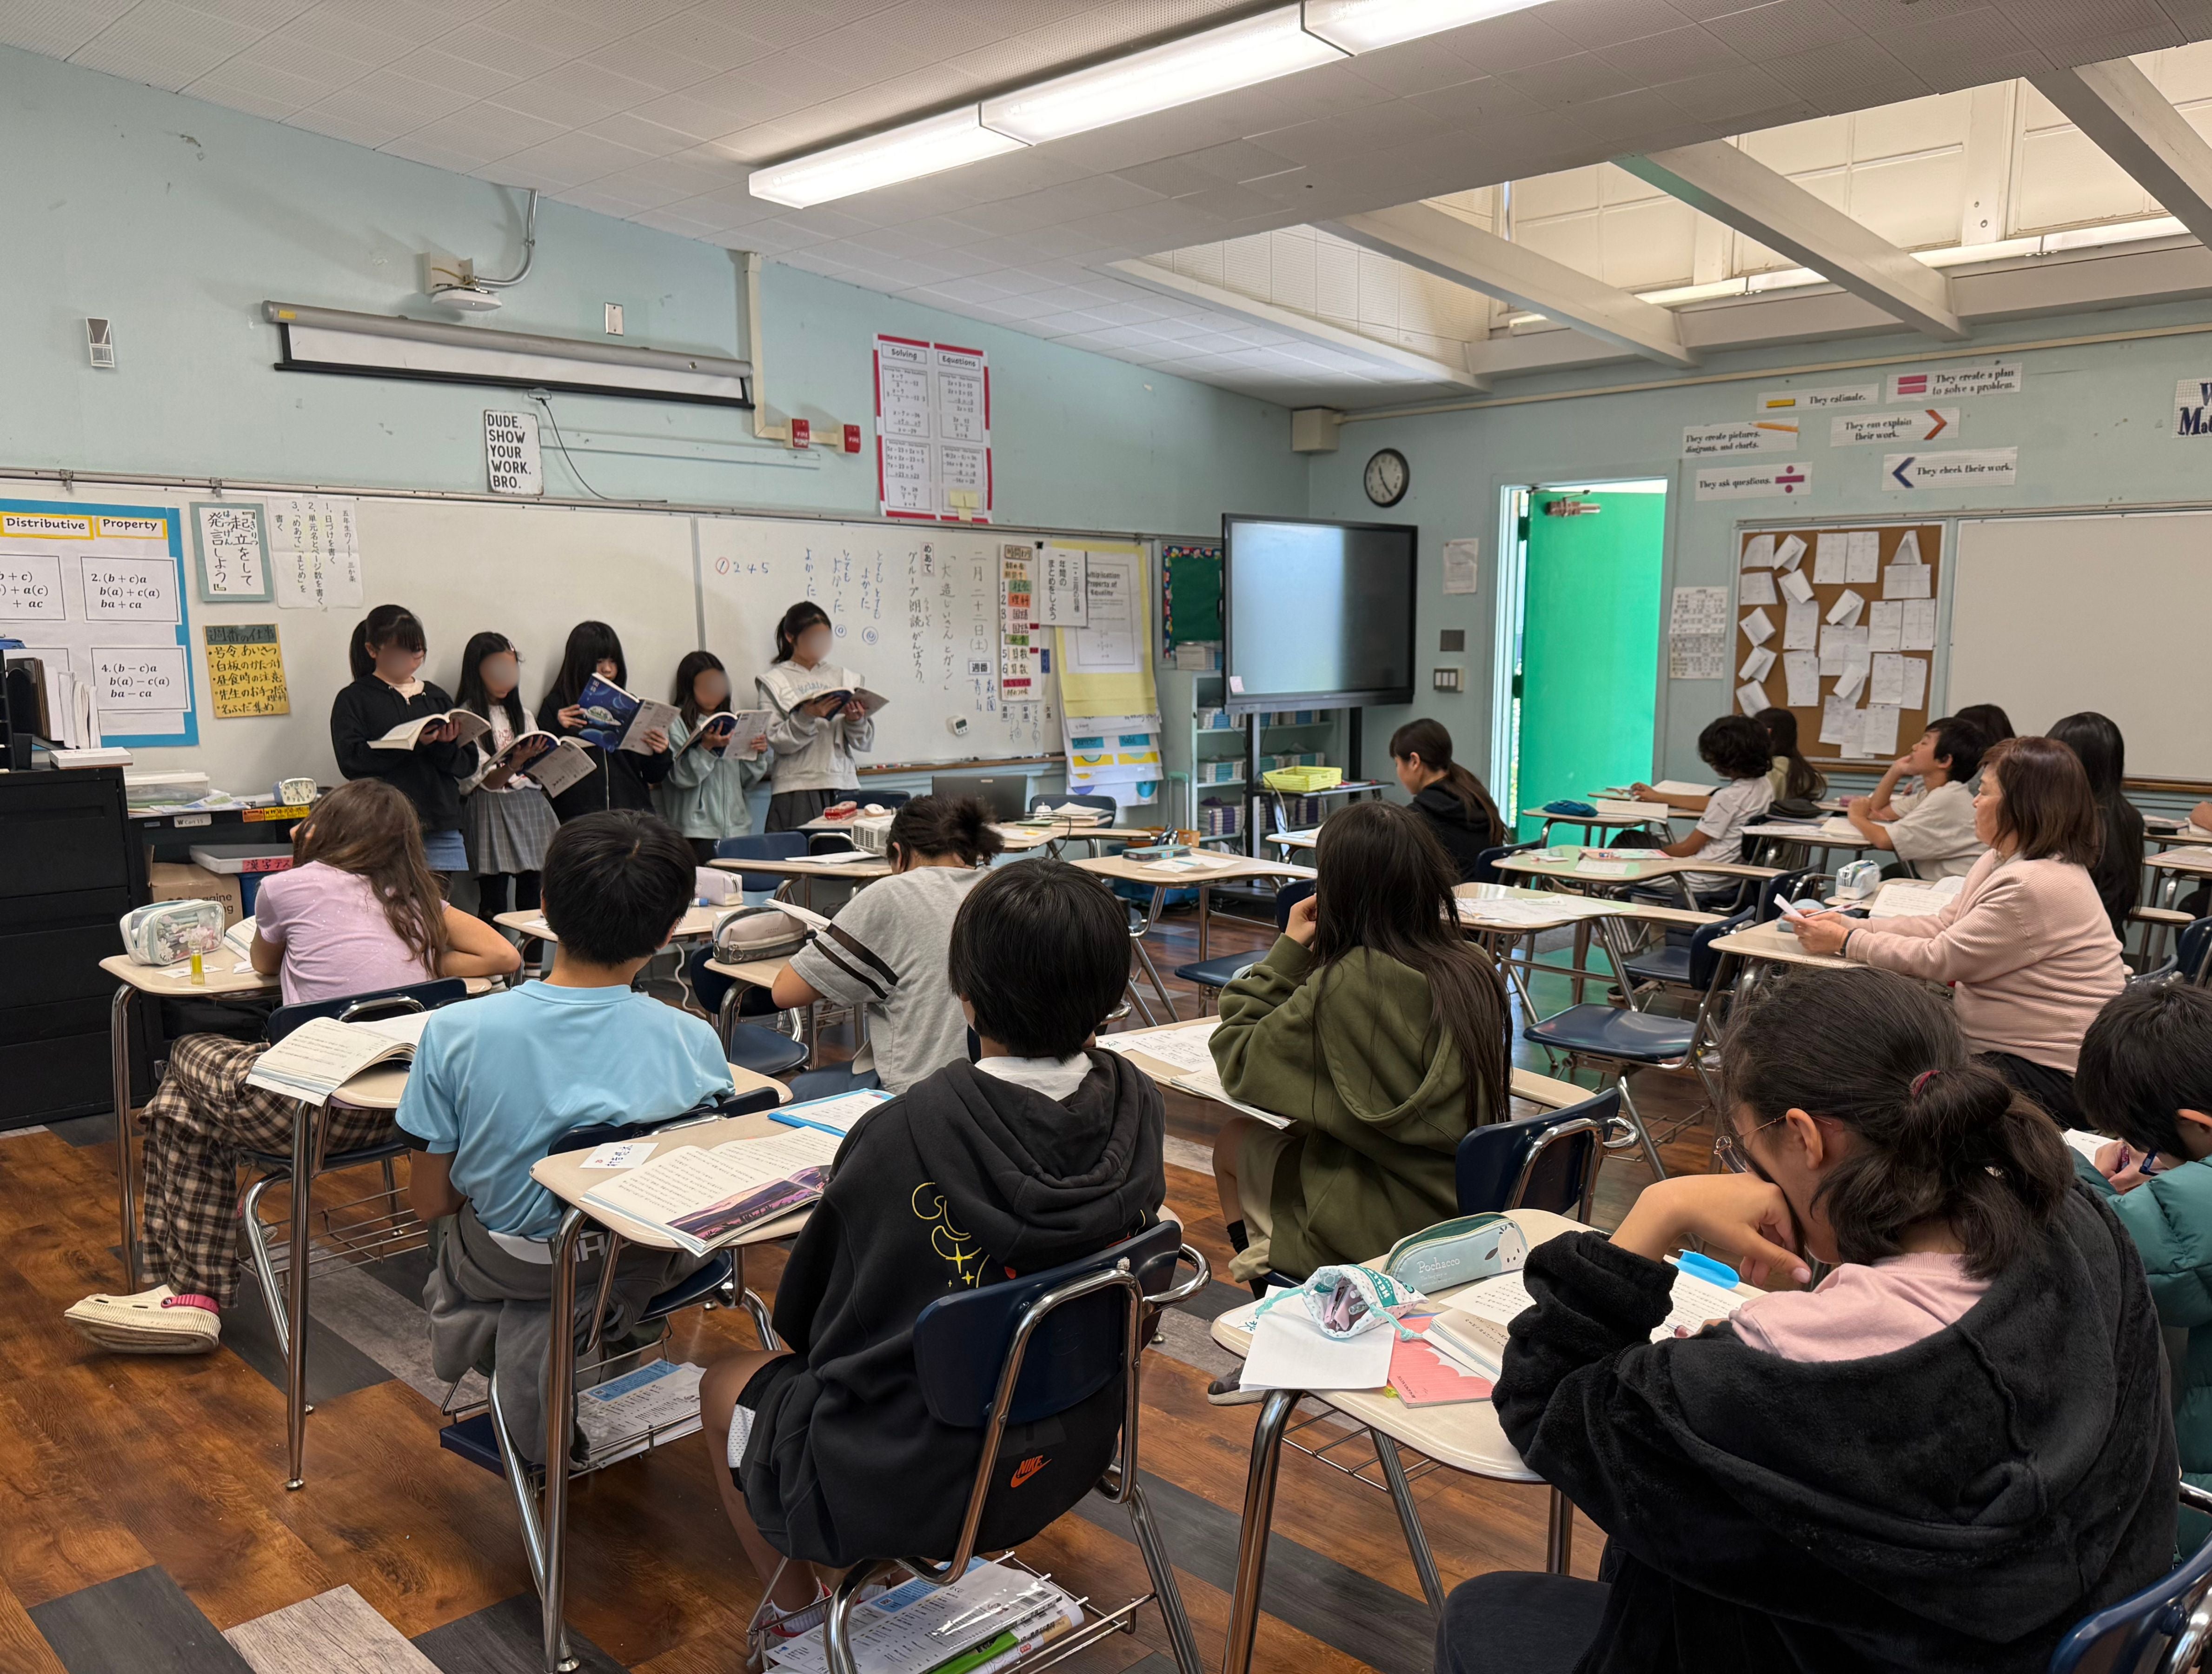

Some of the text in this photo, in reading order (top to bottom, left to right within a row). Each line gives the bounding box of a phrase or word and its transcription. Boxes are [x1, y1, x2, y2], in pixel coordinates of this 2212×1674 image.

[891, 348, 917, 360] Solving
[942, 355, 976, 367] Equations
[1936, 374, 1955, 384] They
[1959, 371, 1985, 381] create
[1995, 368, 2014, 380] plan
[1933, 387, 1942, 395] to
[1944, 385, 1966, 395] solve
[1810, 396, 1827, 405] They
[488, 414, 522, 429] DUDE.
[1846, 422, 1863, 431] They
[1883, 418, 1912, 429] explain
[489, 430, 525, 444] SHOW
[1687, 435, 1702, 443] They
[1855, 431, 1874, 440] their
[491, 445, 521, 458] YOUR
[492, 460, 531, 475] WORK.
[1917, 467, 1936, 477] They
[493, 475, 521, 488] BRO.
[7, 518, 157, 531] Distributive Property
[24, 585, 48, 596] a(c)
[1002, 582, 1005, 591] 1
[100, 587, 123, 598] b(a)
[138, 588, 160, 599] c(a)
[28, 600, 43, 608] ac
[101, 600, 115, 608] ba
[1001, 595, 1006, 604] 2
[1001, 609, 1006, 619] 3
[1002, 624, 1006, 633] 4
[1003, 650, 1007, 658] 5
[972, 663, 988, 672] 週番
[1003, 664, 1007, 673] 6
[110, 677, 133, 687] b(a)
[148, 677, 170, 687] c(a)
[1417, 1257, 1460, 1273] Pochacco
[1017, 1455, 1043, 1475] NIKE
